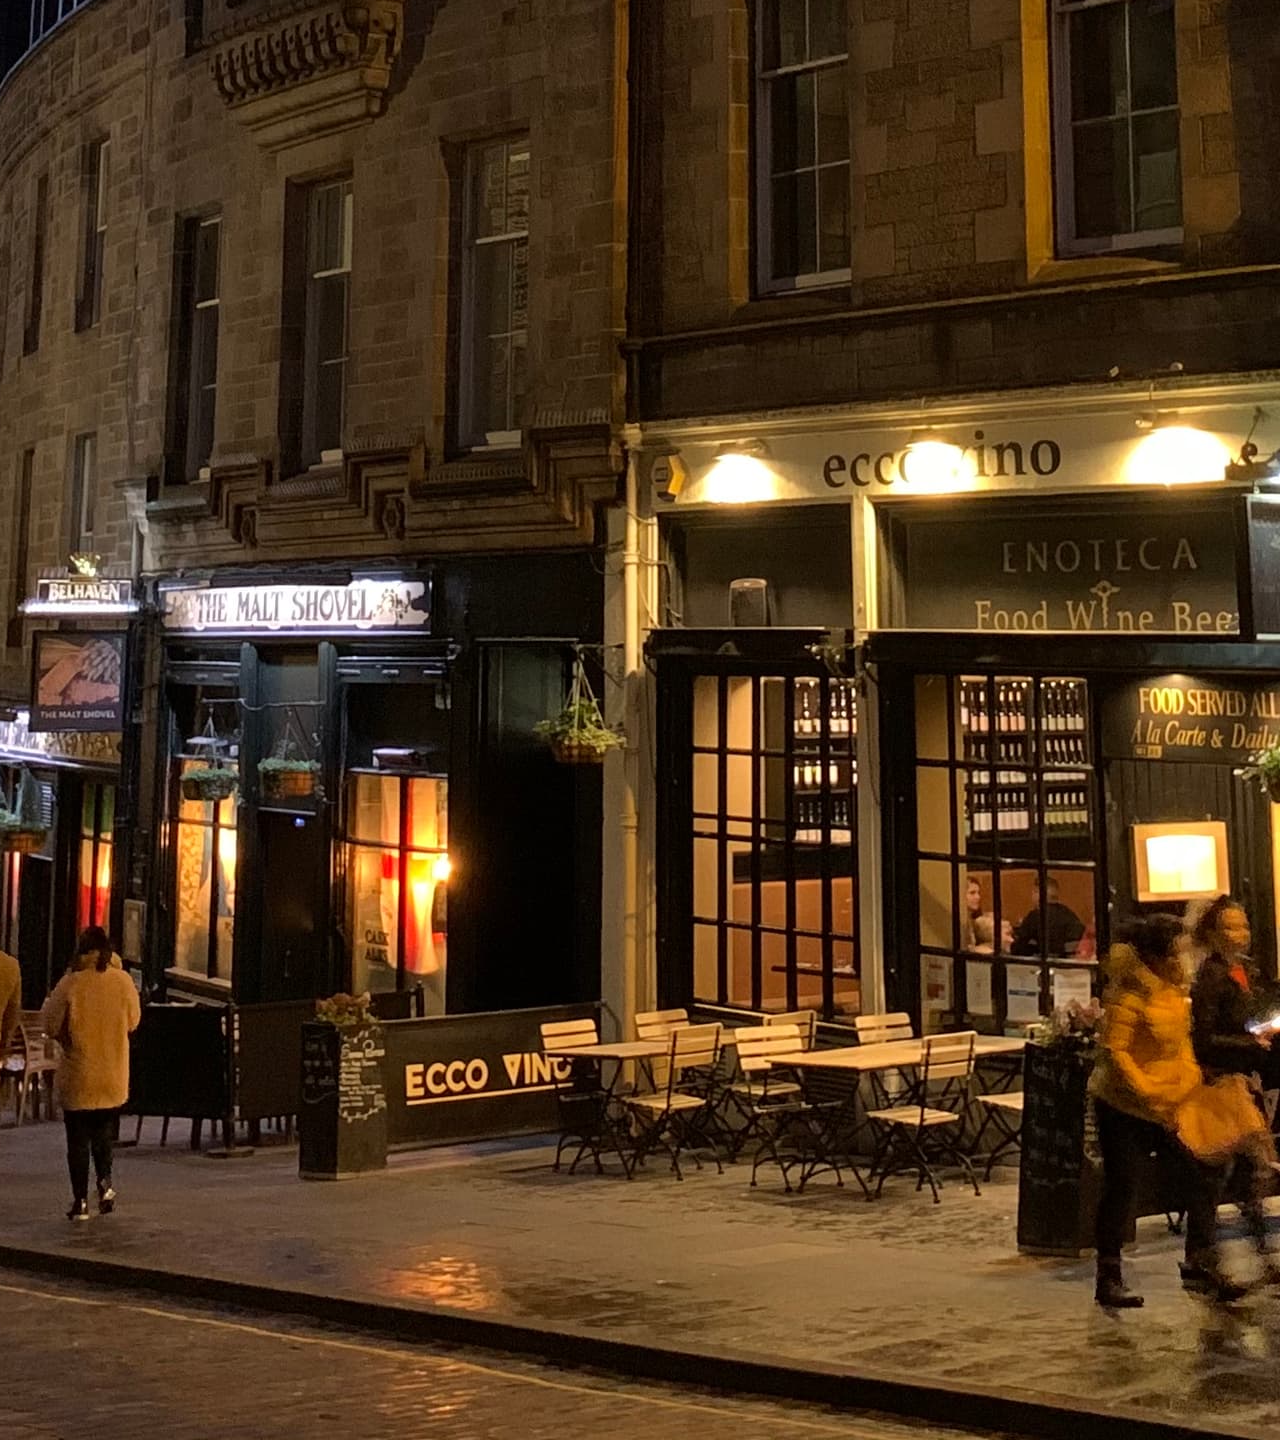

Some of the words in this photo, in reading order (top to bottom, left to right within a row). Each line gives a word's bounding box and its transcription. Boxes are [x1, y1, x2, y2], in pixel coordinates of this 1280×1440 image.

[1002, 538, 1198, 573] ENOTECA
[48, 582, 121, 602] BELHAVEN
[195, 593, 228, 623] THE
[236, 590, 284, 623] MALT
[291, 588, 374, 622] SHOVEL
[974, 599, 1049, 630] Food
[1171, 601, 1234, 632] Bee
[40, 710, 57, 719] THE
[58, 710, 81, 719] MALT
[82, 710, 116, 719] SHOVEL
[1138, 687, 1185, 715] FOOD
[1186, 688, 1247, 717] SERVED
[1249, 691, 1280, 719] ALL
[1130, 719, 1143, 744] A
[1145, 720, 1162, 745] la
[1164, 720, 1206, 748] Carte
[1209, 728, 1224, 749] &
[405, 1058, 490, 1098] ECCO
